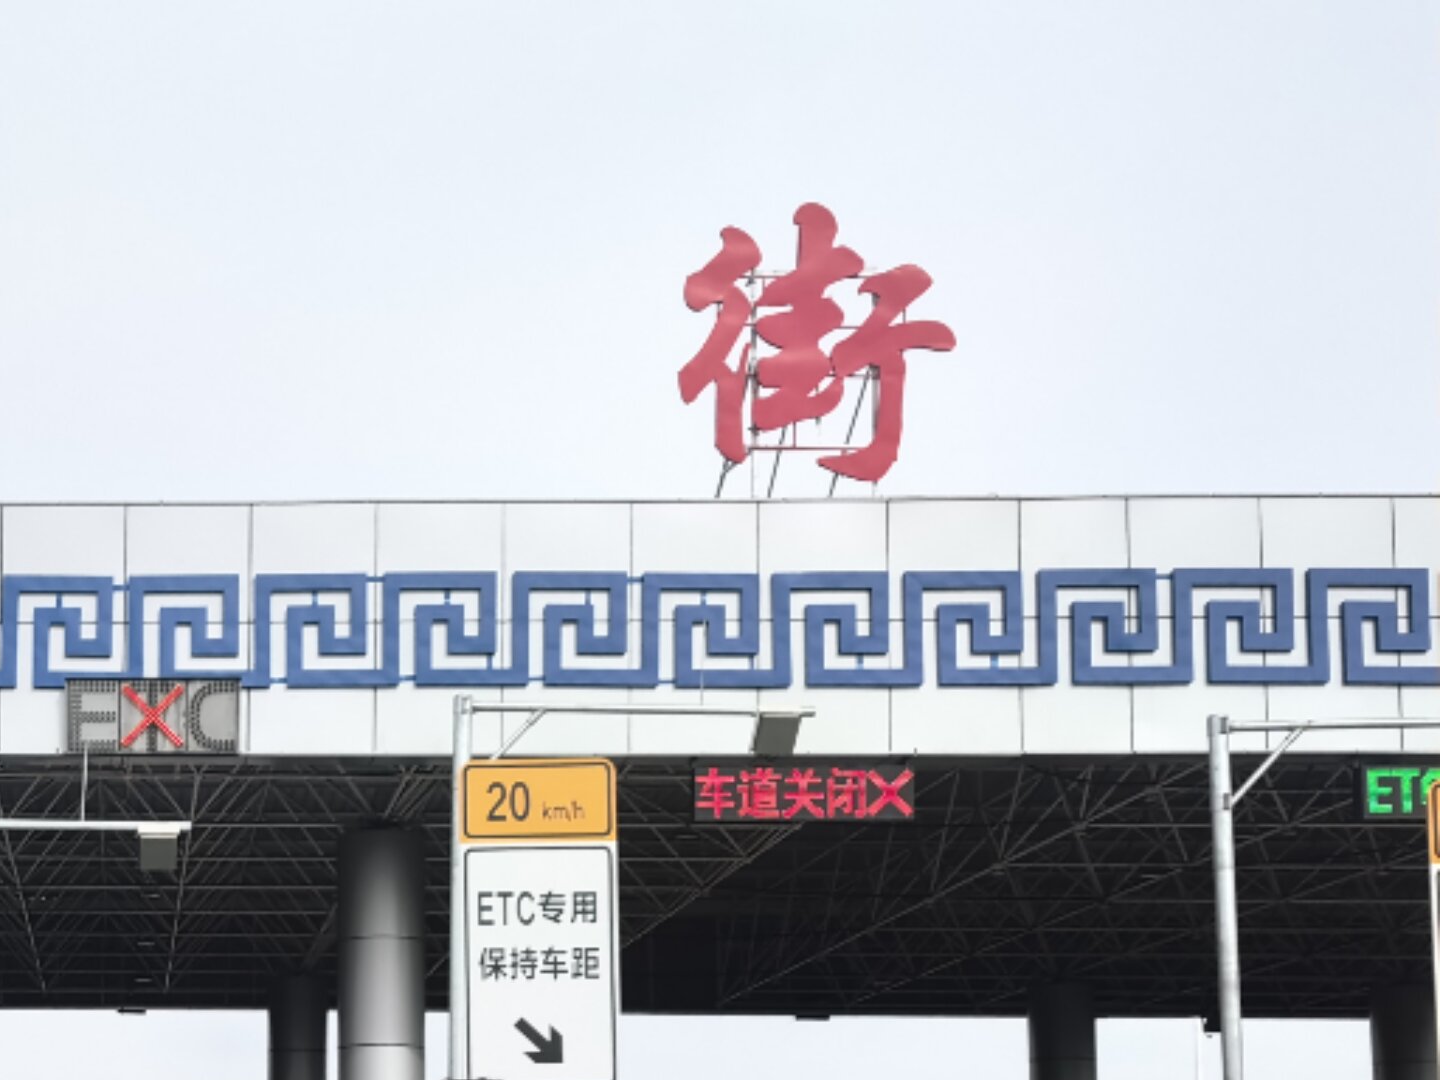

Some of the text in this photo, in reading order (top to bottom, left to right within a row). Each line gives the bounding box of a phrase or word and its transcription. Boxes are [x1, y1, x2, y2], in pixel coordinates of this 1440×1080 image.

[678, 202, 957, 482] 街
[486, 781, 585, 822] 20 km/h
[477, 891, 597, 926] ETC专用
[479, 947, 600, 981] 保持车距
